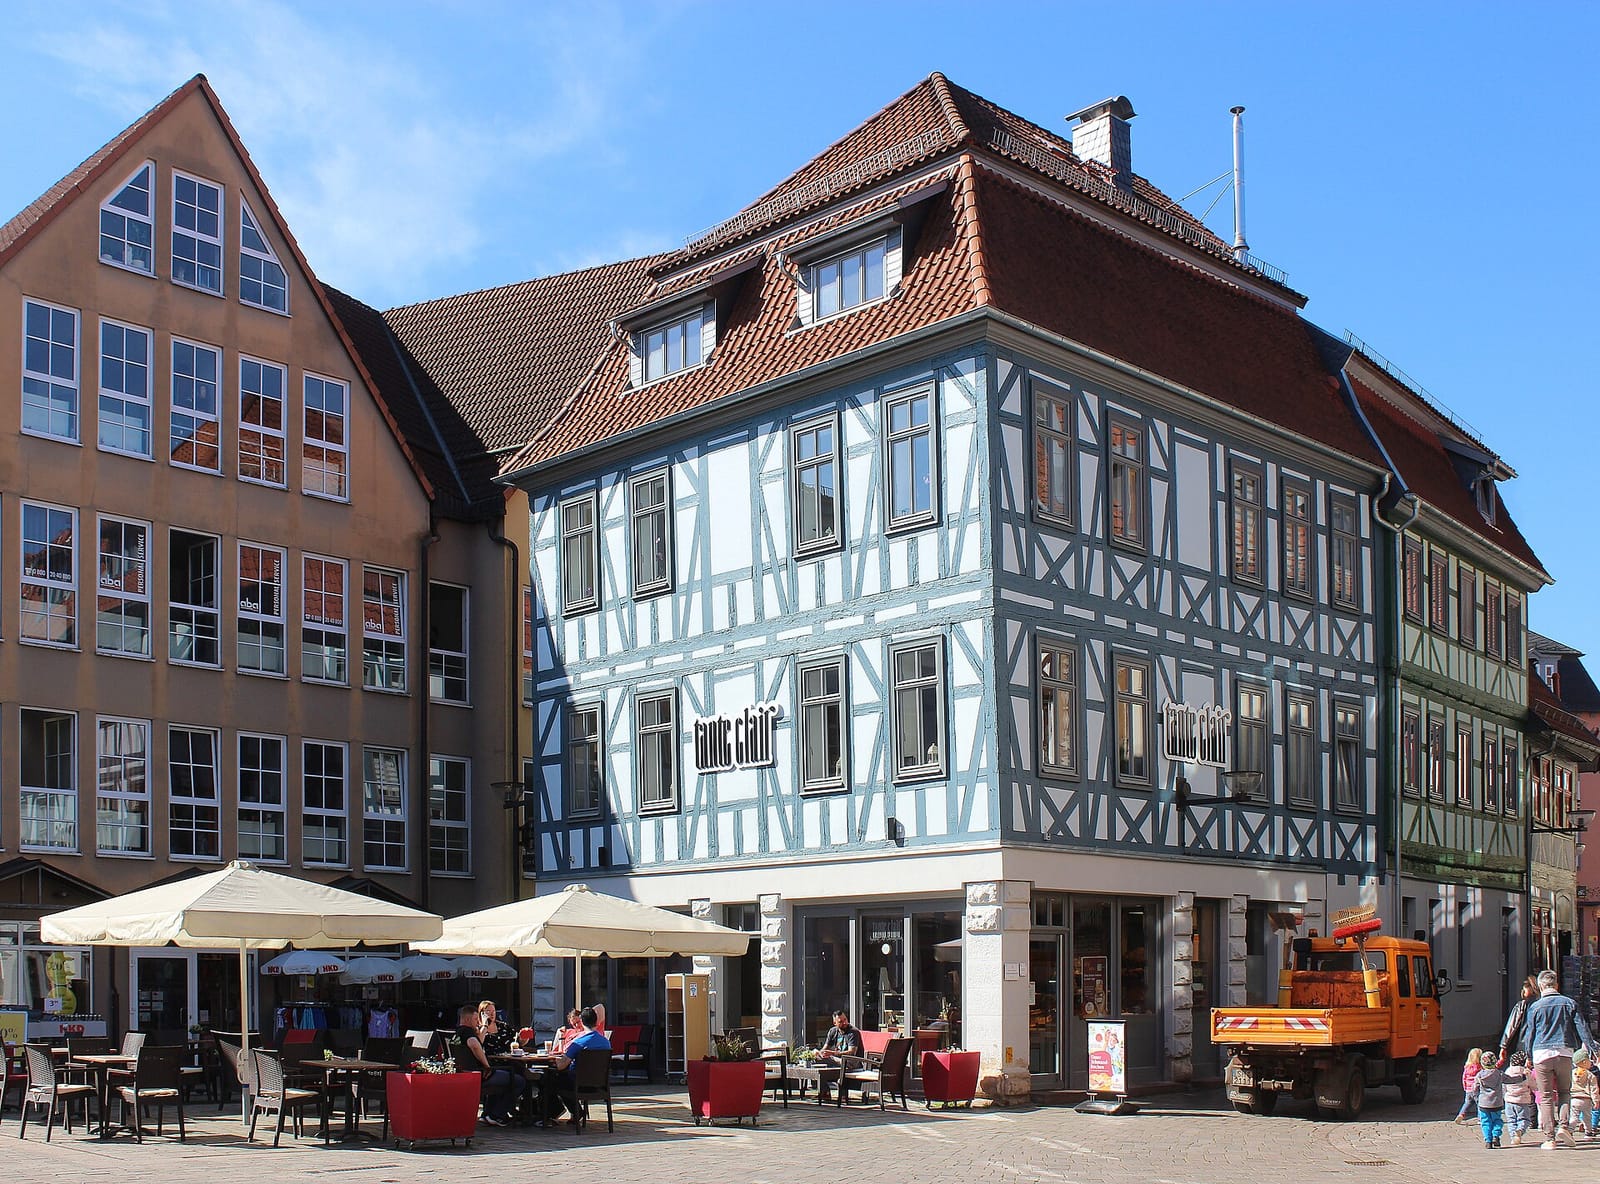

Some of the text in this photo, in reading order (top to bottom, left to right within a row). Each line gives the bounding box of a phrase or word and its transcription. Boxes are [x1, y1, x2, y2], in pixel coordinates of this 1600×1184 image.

[100, 574, 121, 587] aba
[240, 597, 259, 609] aba
[365, 618, 382, 630] aba
[694, 706, 776, 770] tante clair
[1165, 703, 1230, 763] tante clair
